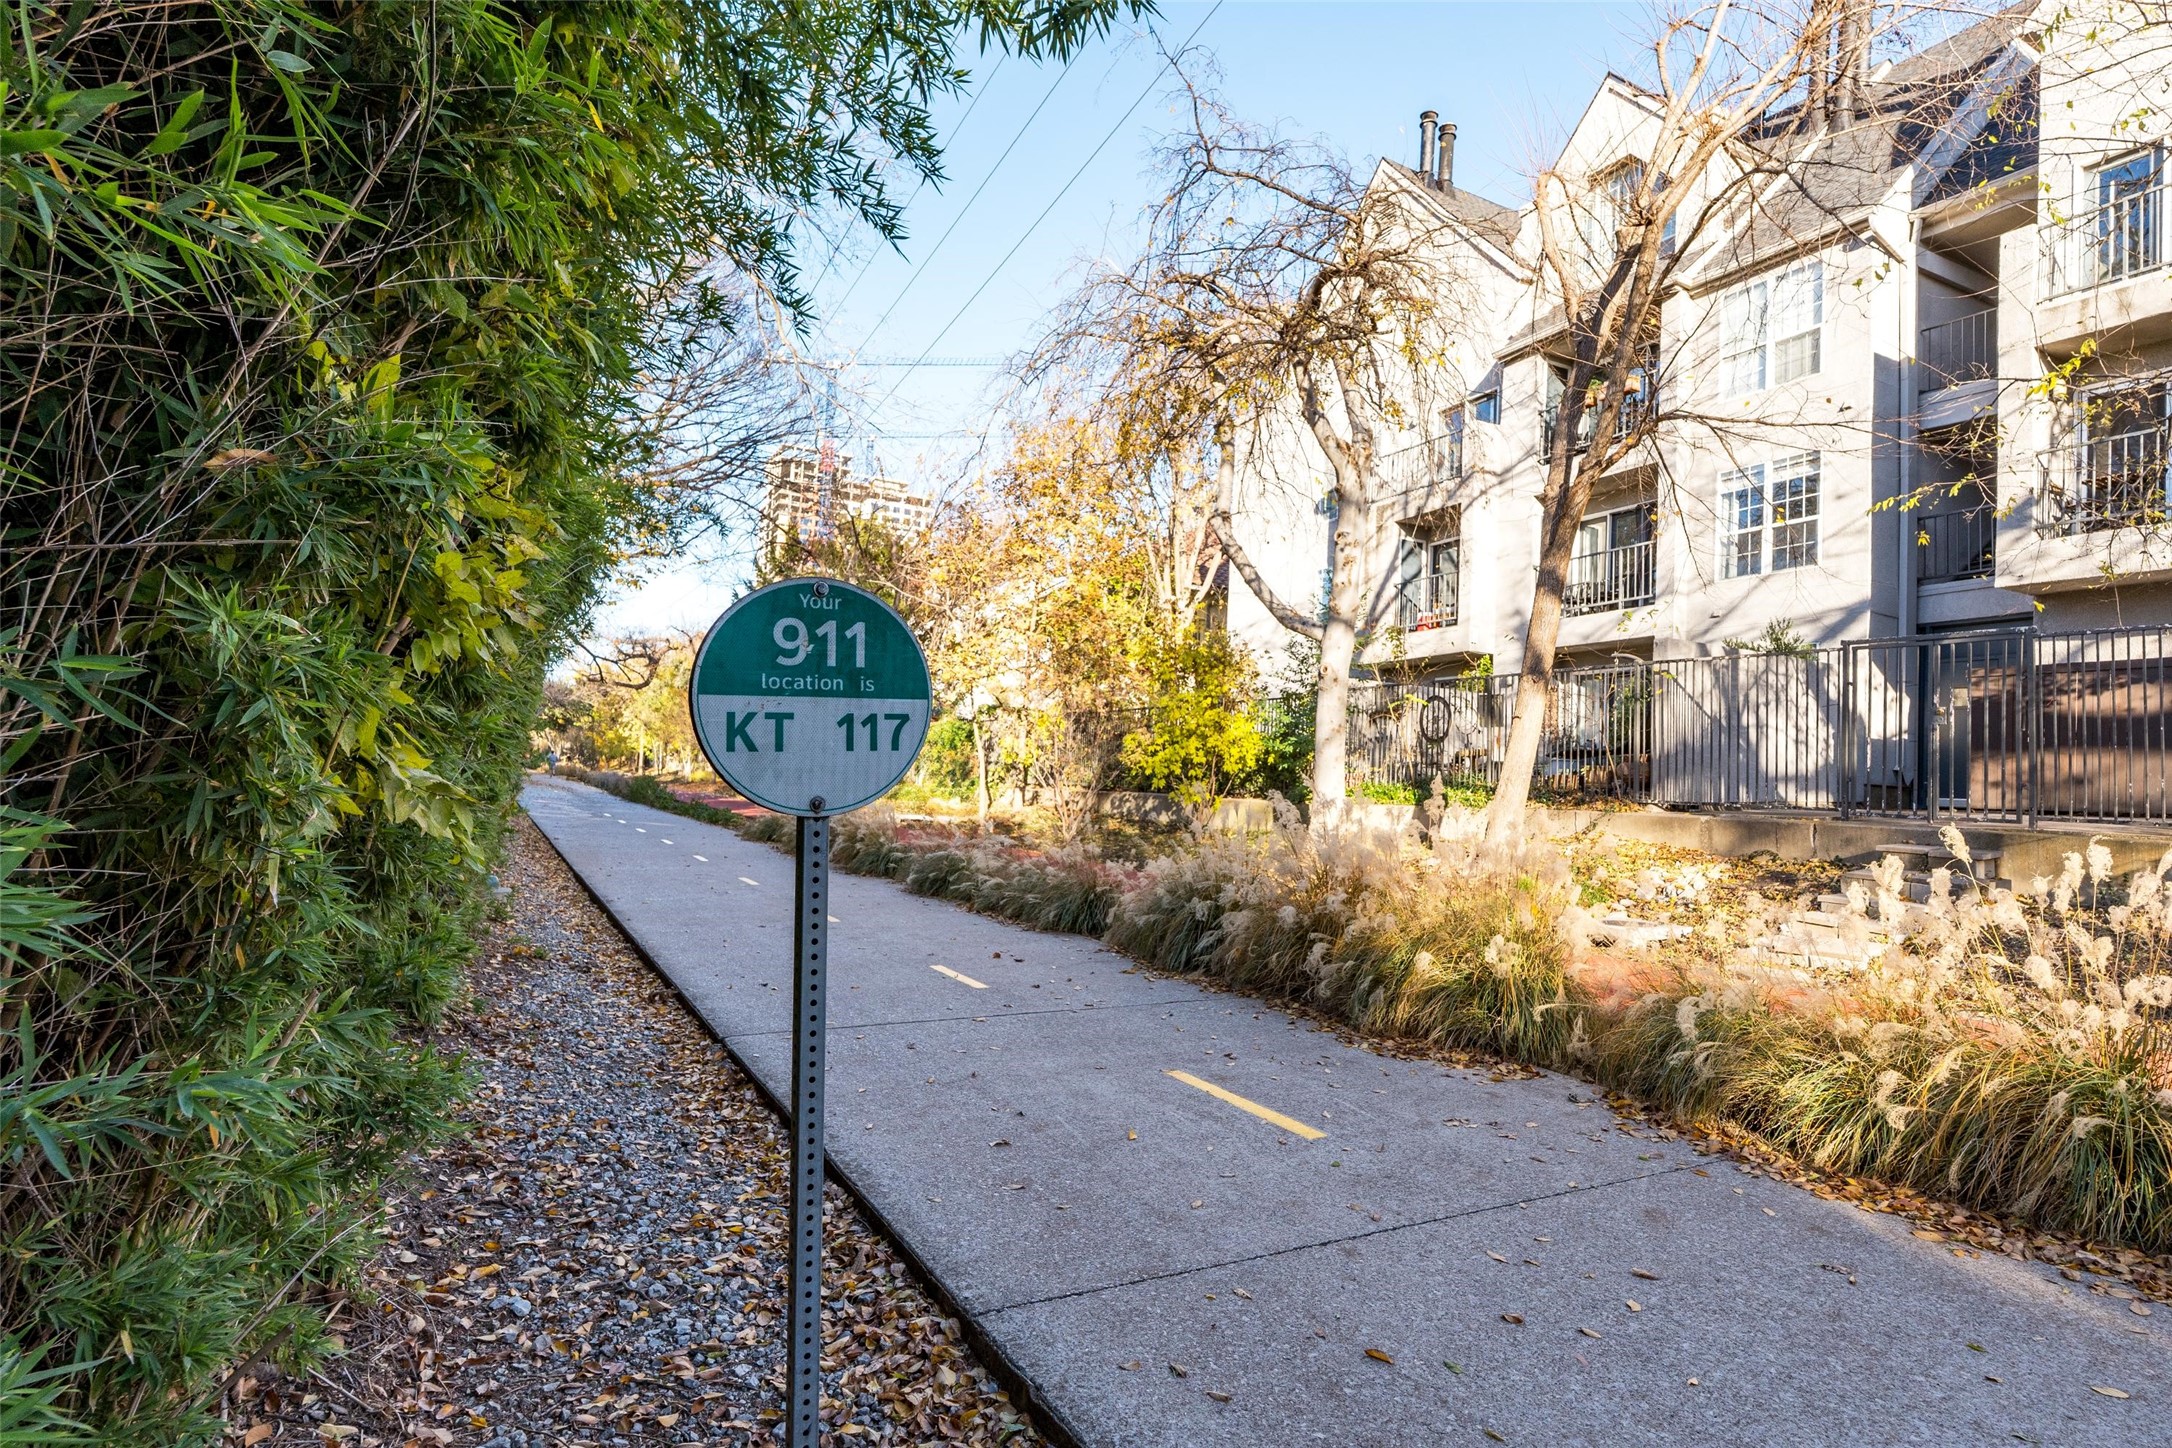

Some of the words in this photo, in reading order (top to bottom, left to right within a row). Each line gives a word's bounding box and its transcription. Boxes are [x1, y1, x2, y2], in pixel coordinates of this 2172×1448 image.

[799, 593, 842, 610] Your
[772, 617, 866, 668] 911
[761, 673, 844, 691] location
[860, 676, 875, 692] is
[725, 711, 795, 753] KT
[836, 712, 911, 752] 117
